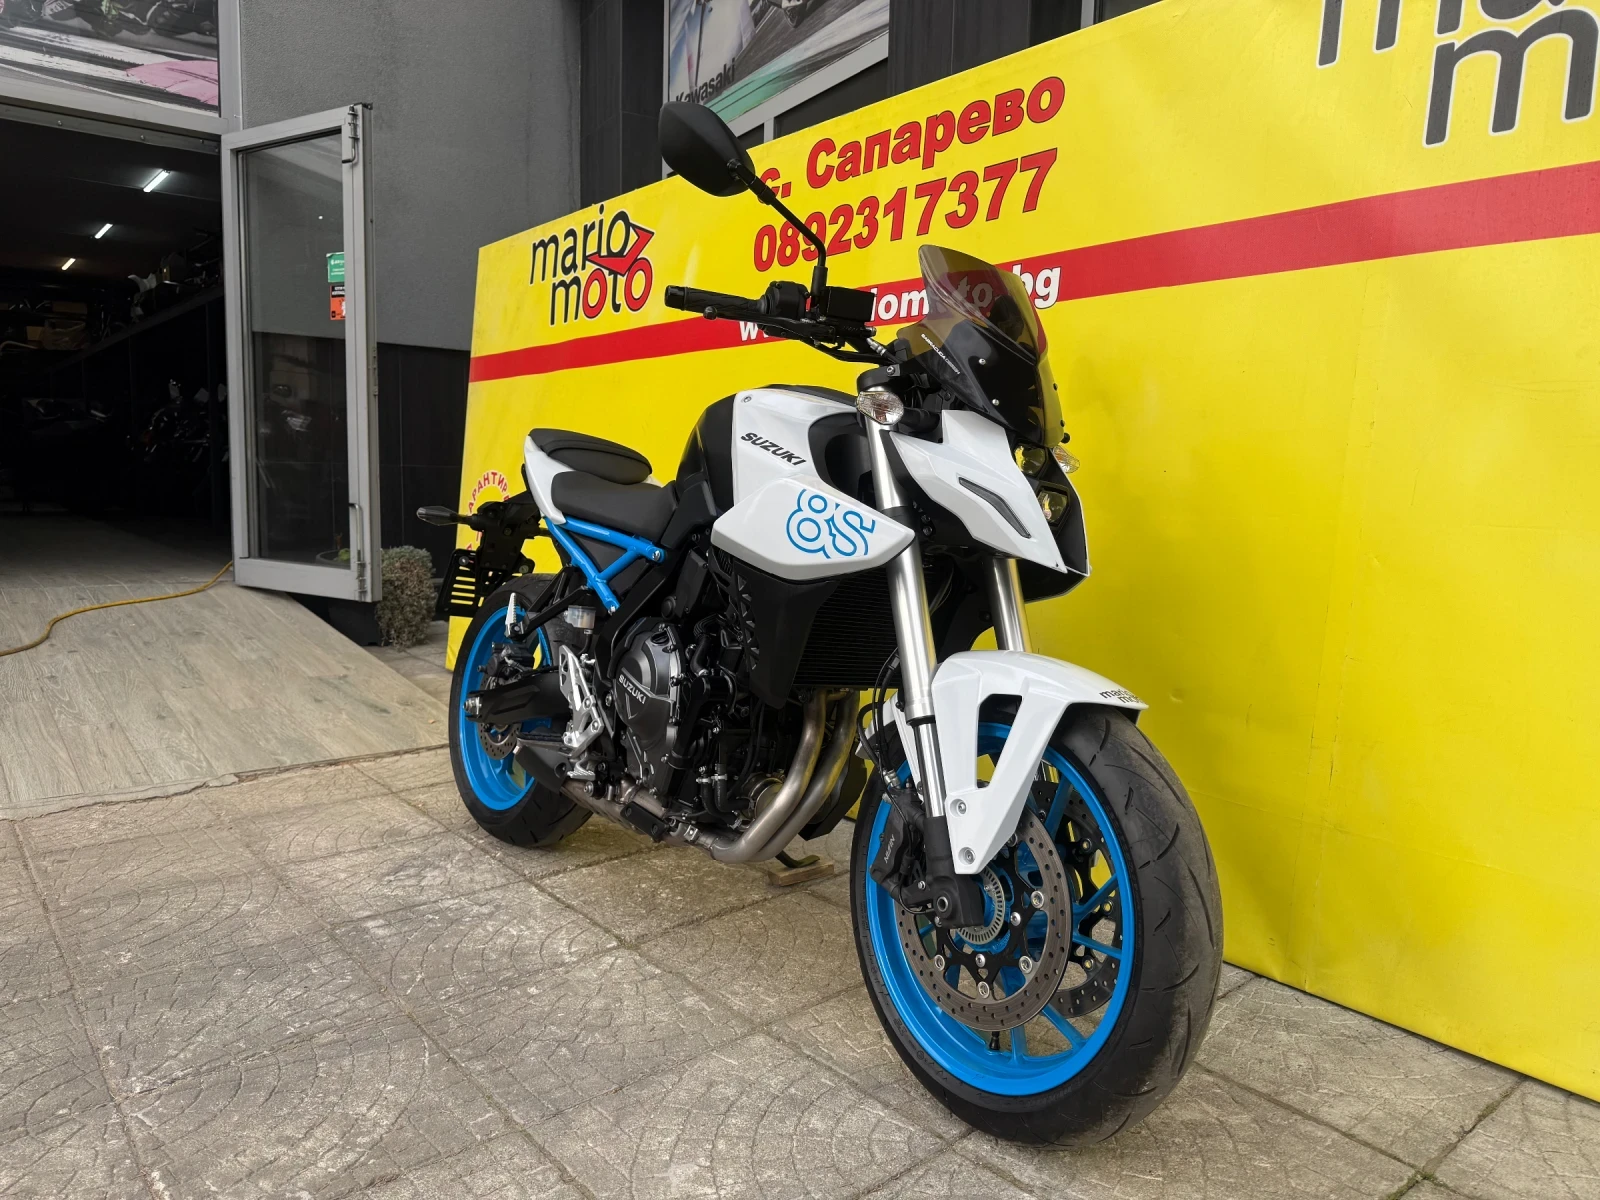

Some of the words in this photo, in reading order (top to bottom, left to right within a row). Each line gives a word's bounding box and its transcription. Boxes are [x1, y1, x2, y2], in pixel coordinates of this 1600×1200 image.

[806, 76, 1066, 190] Сапарево
[529, 203, 631, 285] mario
[753, 147, 1058, 272] 0892317377
[550, 257, 653, 326] moto
[740, 431, 807, 467] SUZUKI
[618, 674, 647, 705] SUZUKI
